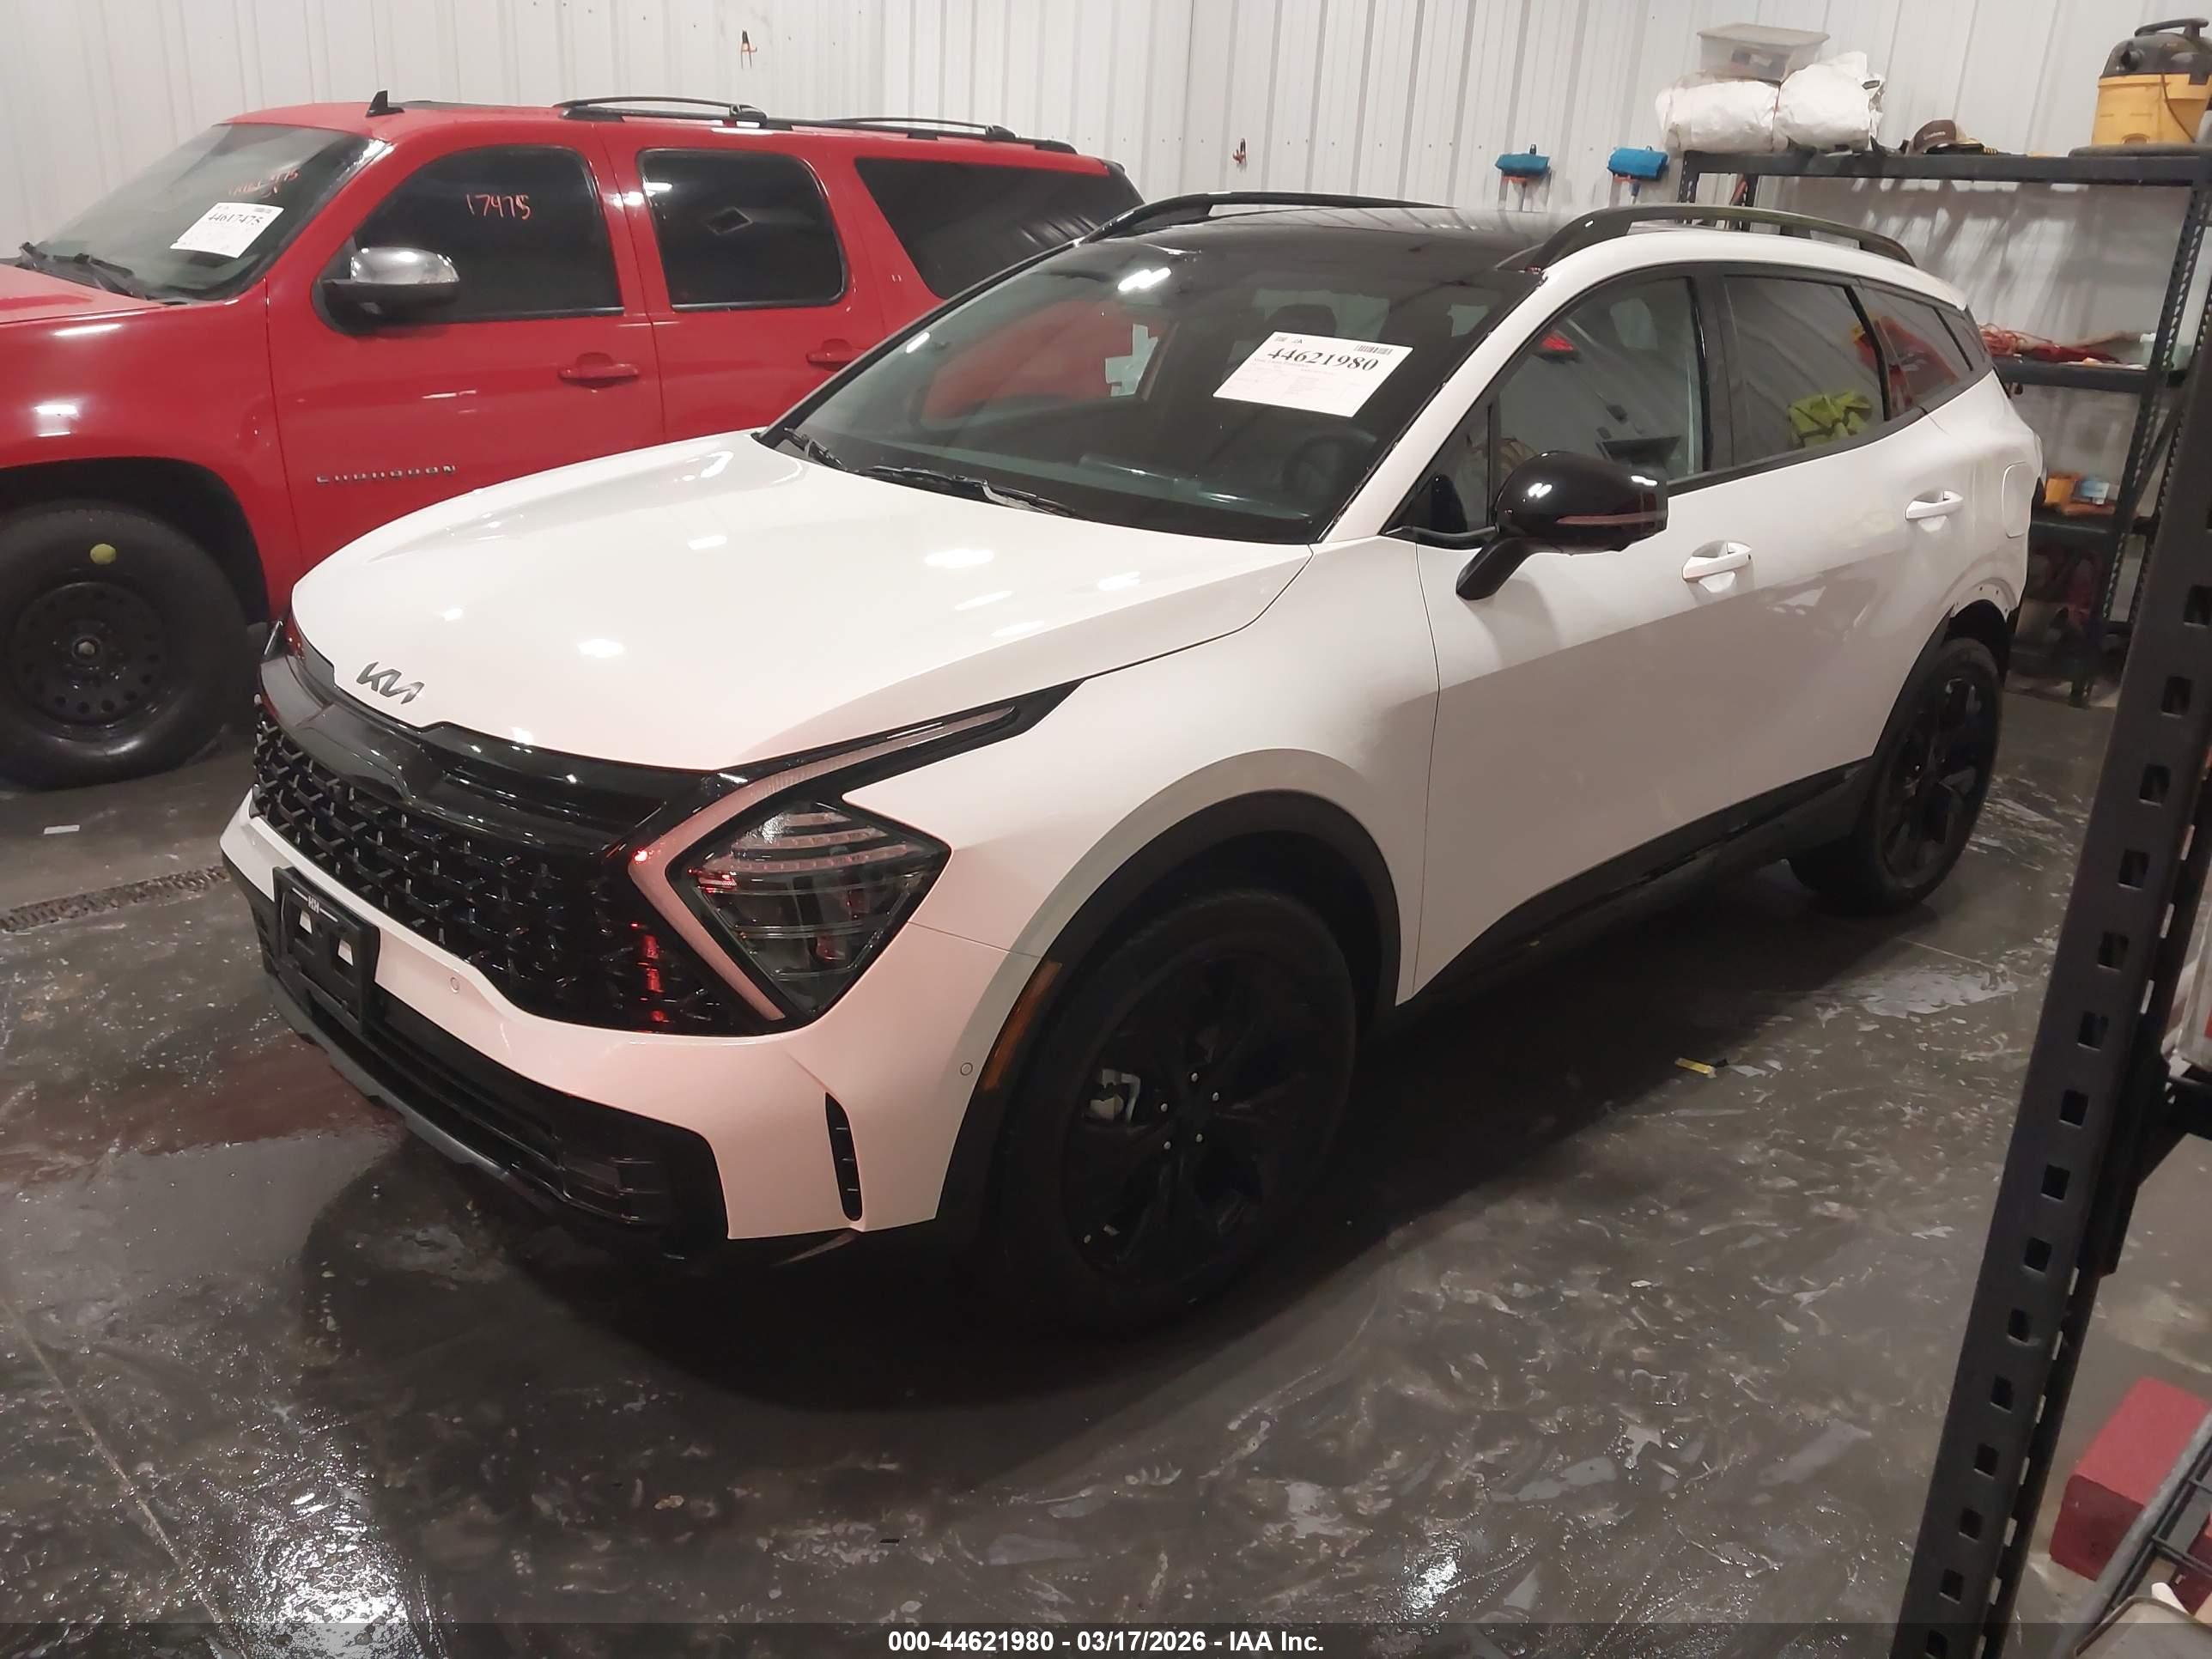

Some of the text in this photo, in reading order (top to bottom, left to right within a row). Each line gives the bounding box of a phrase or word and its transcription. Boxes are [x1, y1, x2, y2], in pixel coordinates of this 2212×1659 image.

[466, 193, 532, 220] 17475
[1267, 348, 1379, 371] 44621980
[356, 661, 425, 704] KIA
